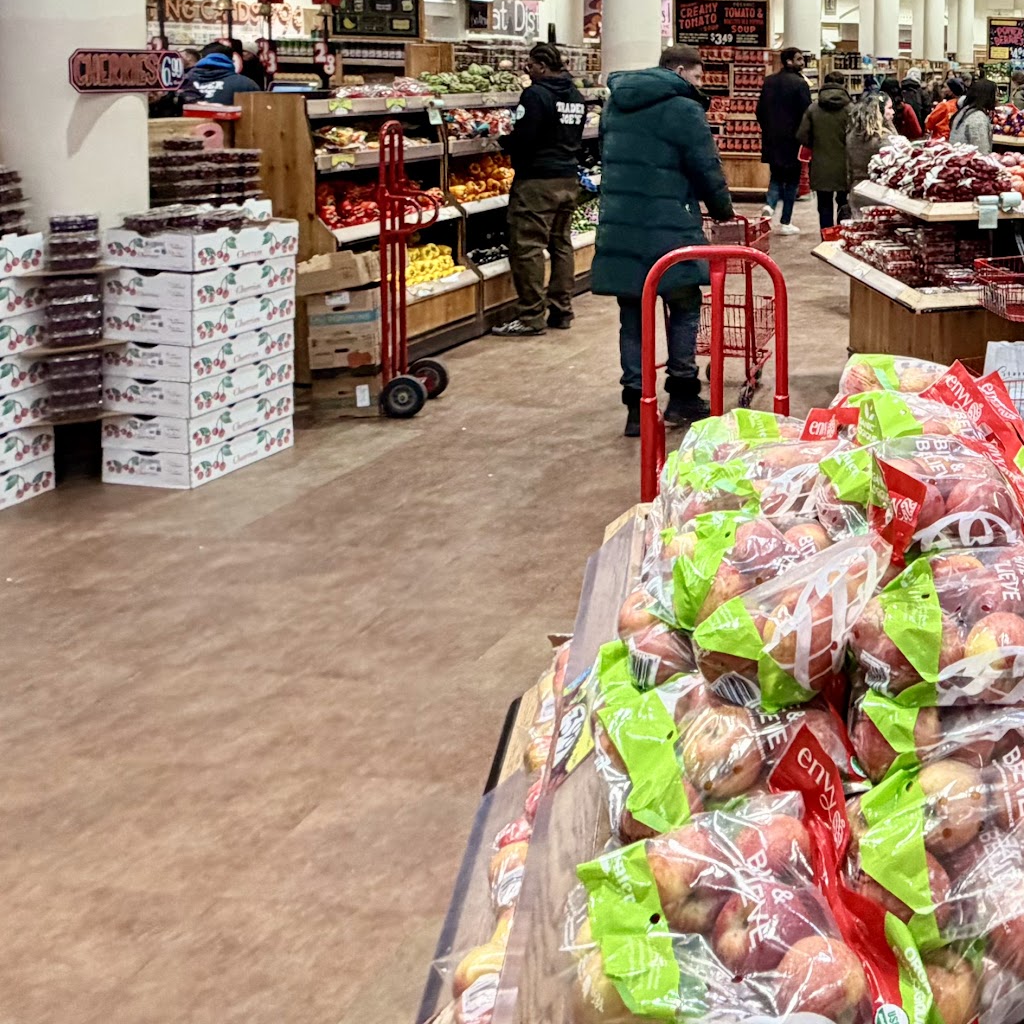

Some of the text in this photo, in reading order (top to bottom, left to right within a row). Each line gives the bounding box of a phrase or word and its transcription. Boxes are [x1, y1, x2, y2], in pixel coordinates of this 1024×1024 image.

[492, 2, 507, 31] at
[680, 2, 718, 18] CREAMY
[724, 8, 764, 19] TOMATO &
[679, 14, 717, 30] TOMATO
[731, 25, 756, 33] SOUP
[77, 53, 158, 87] CHERRIES
[556, 101, 585, 114] TRADER
[560, 113, 583, 125] JOE'S
[797, 747, 837, 812] envy
